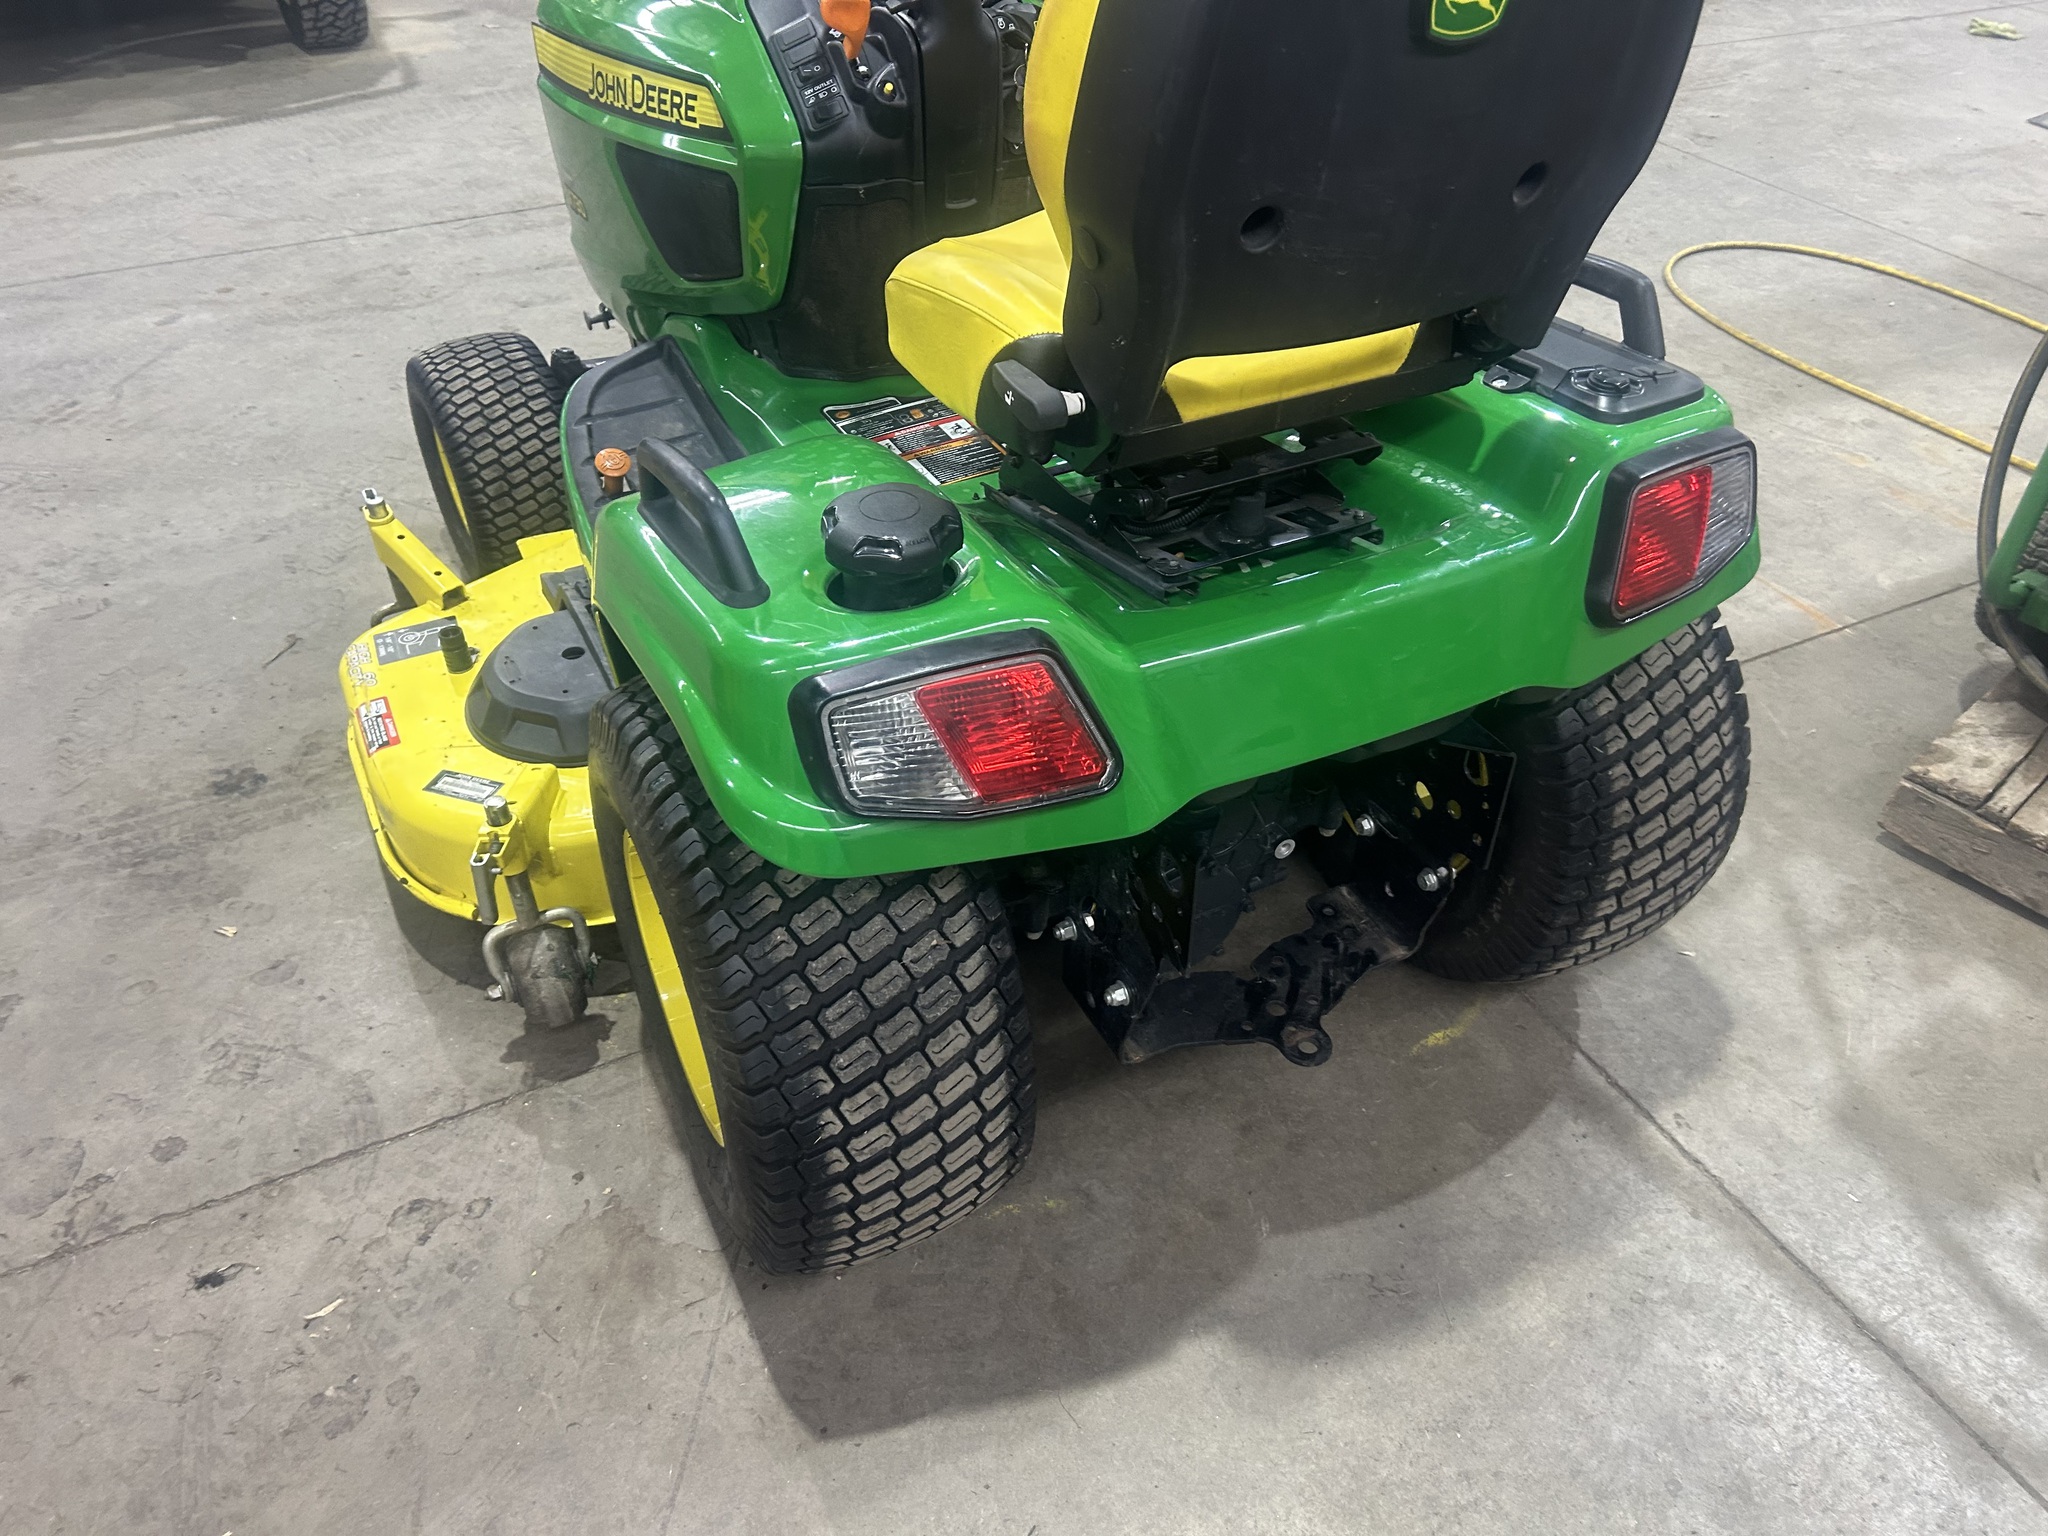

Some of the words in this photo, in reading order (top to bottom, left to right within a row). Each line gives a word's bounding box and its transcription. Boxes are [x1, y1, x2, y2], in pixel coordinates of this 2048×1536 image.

[814, 79, 833, 91] OUTLET
[588, 63, 628, 106] JOHN
[631, 73, 698, 124] DEERE
[900, 424, 931, 434] DANGER
[920, 444, 952, 456] WARNING
[363, 672, 378, 686] 60
